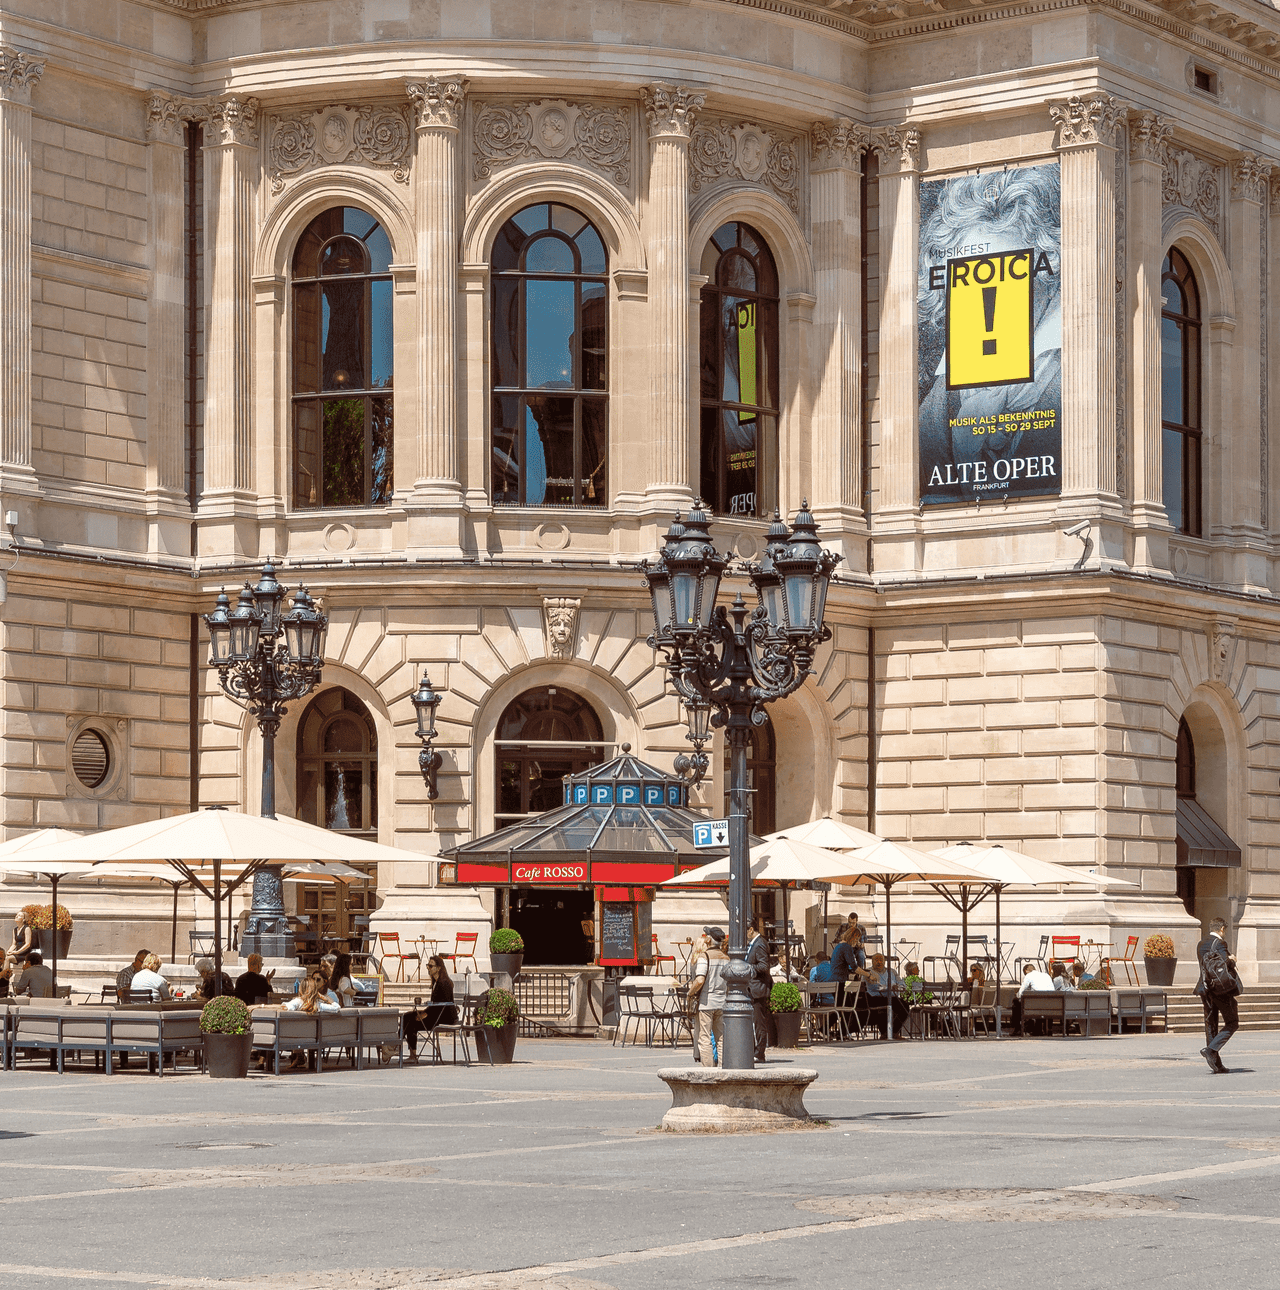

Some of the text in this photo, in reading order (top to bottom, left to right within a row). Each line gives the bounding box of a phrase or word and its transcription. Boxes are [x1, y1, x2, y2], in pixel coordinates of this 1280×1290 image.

[929, 242, 991, 259] MUSIKFEST
[929, 251, 1054, 290] EROICA
[949, 409, 1056, 427] MUSIK ALS BEKENNTNIS
[972, 427, 985, 435] SO
[987, 426, 996, 434] 15
[1005, 423, 1018, 432] SO
[1020, 422, 1031, 431] 29
[1033, 419, 1056, 429] SEPT
[928, 455, 1056, 486] ALTE OPER
[972, 482, 1010, 491] FRANKFURT
[578, 788, 586, 804] P
[596, 788, 608, 804] P
[622, 788, 634, 804] P
[648, 789, 659, 804] P
[669, 790, 677, 805] P
[698, 829, 708, 844] P
[516, 866, 584, 881] Café ROSSO
